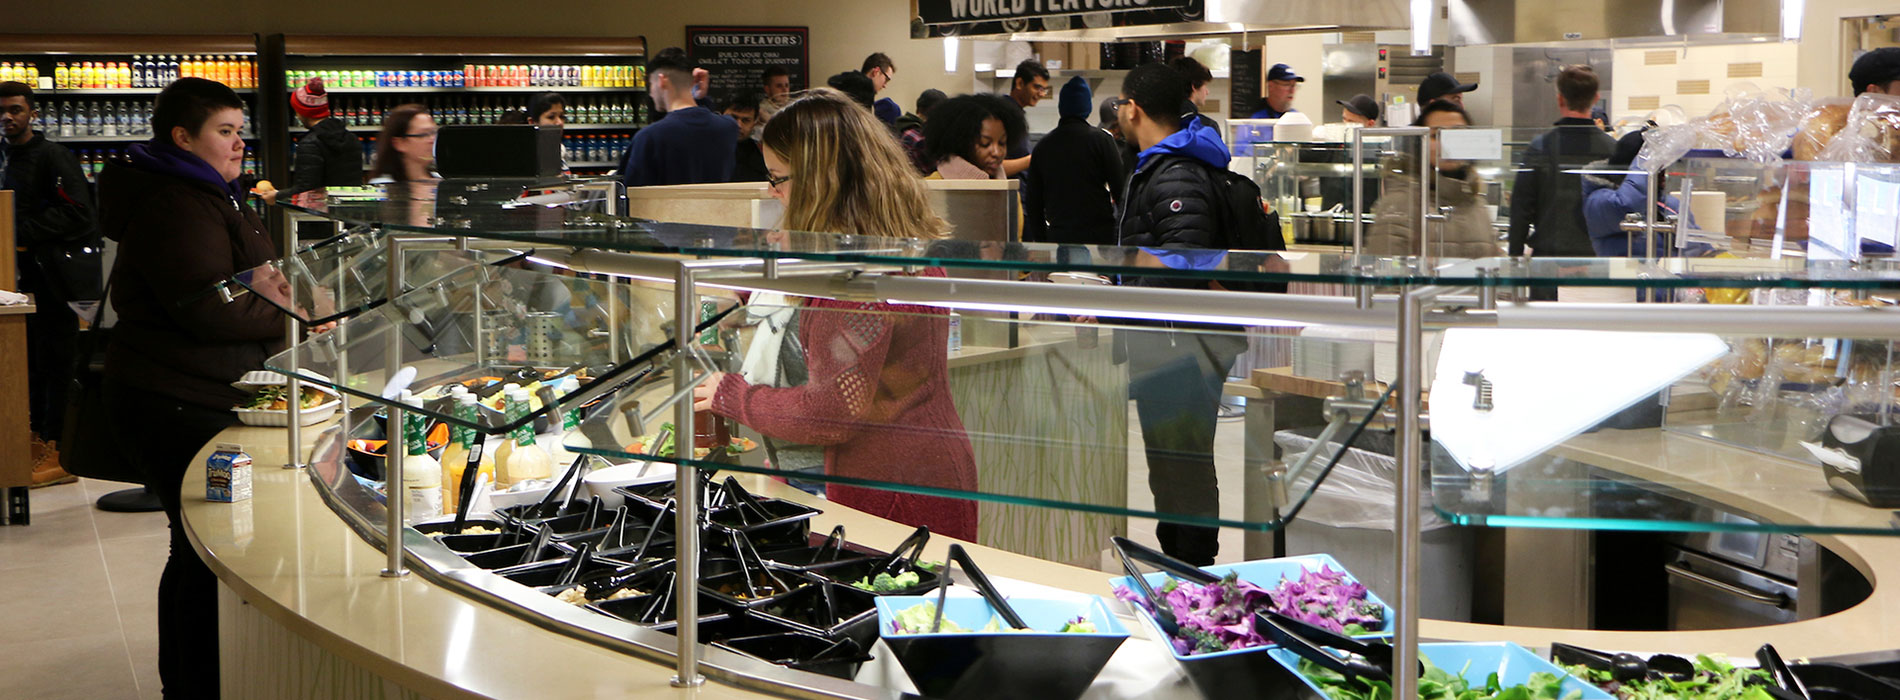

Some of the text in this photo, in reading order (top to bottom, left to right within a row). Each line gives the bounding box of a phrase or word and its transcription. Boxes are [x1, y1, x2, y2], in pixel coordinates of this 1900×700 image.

[950, 0, 1026, 18] WORLD
[698, 36, 797, 45] WORLD FLAVORS
